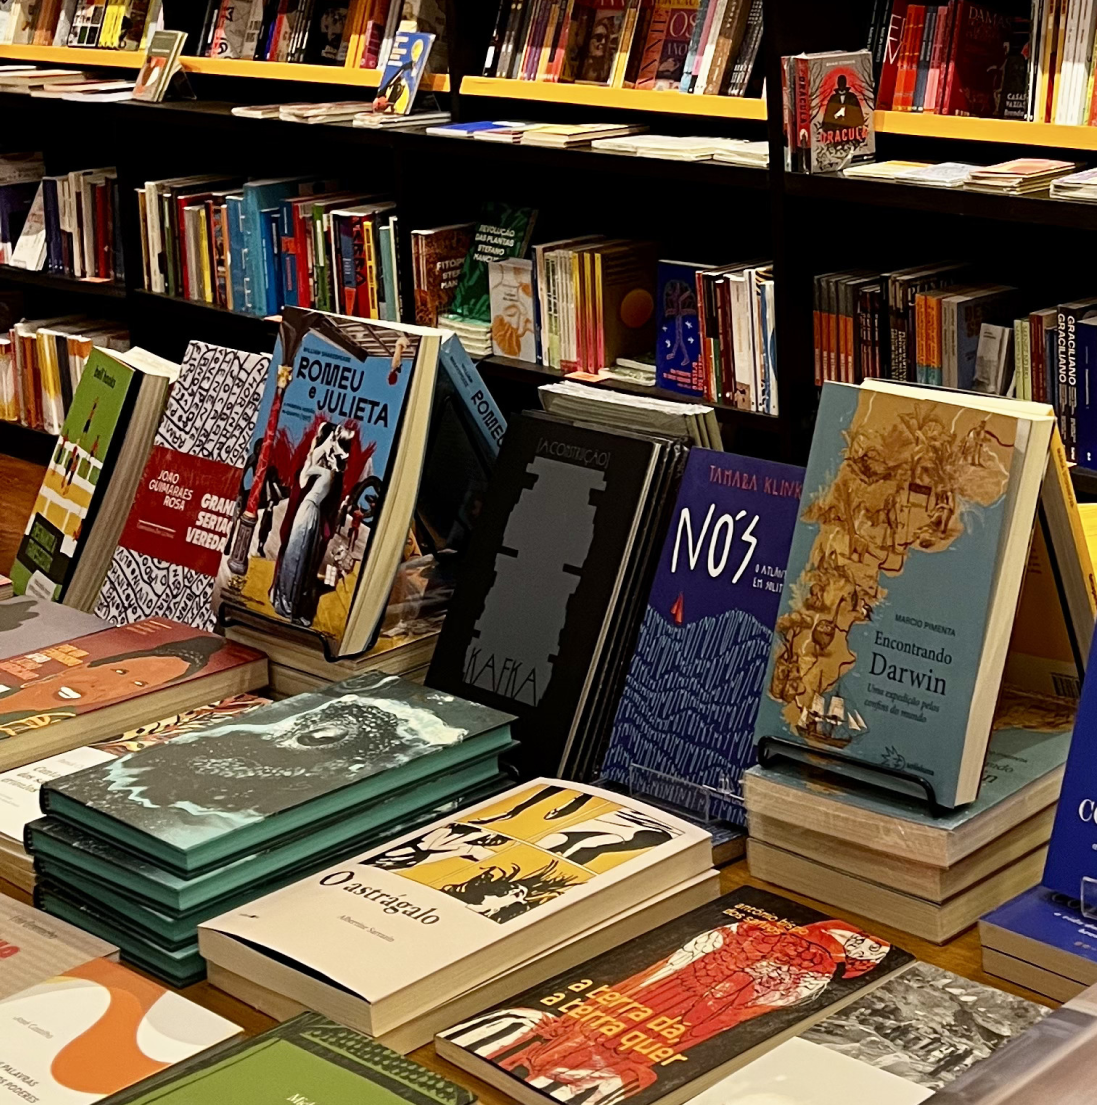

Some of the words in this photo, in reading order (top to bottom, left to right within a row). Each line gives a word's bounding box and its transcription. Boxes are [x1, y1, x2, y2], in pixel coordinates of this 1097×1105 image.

[475, 233, 487, 242] DAS
[488, 234, 514, 247] PLANTAS
[477, 245, 505, 256] STEFANO
[1057, 313, 1067, 383] GRACILIANO
[1066, 315, 1077, 385] GRACILIANO
[296, 357, 365, 393] ROMEU
[317, 389, 389, 428] JULIETA
[709, 465, 758, 491] TAMARA
[163, 495, 185, 511] ROSA
[186, 527, 228, 552] VEREDA
[671, 503, 759, 584] NÓS
[753, 578, 763, 589] EM
[895, 613, 924, 628] MARCIO
[923, 621, 956, 637] PIMENTA
[874, 630, 953, 665] Encontrando
[464, 647, 538, 708] KAFKA
[869, 652, 947, 696] Darwin
[867, 683, 884, 696] Uma
[885, 689, 920, 706] expedição
[921, 697, 940, 713] pelos
[889, 704, 900, 714] do
[901, 708, 927, 723] mundo
[320, 871, 355, 886] O
[343, 882, 440, 925] astrágalo
[722, 907, 742, 920] dos
[568, 979, 593, 993] a
[586, 984, 653, 1021] terra
[646, 1015, 692, 1043] dá,
[540, 992, 566, 1006] a
[558, 999, 629, 1036] terra
[621, 1031, 688, 1067] quer
